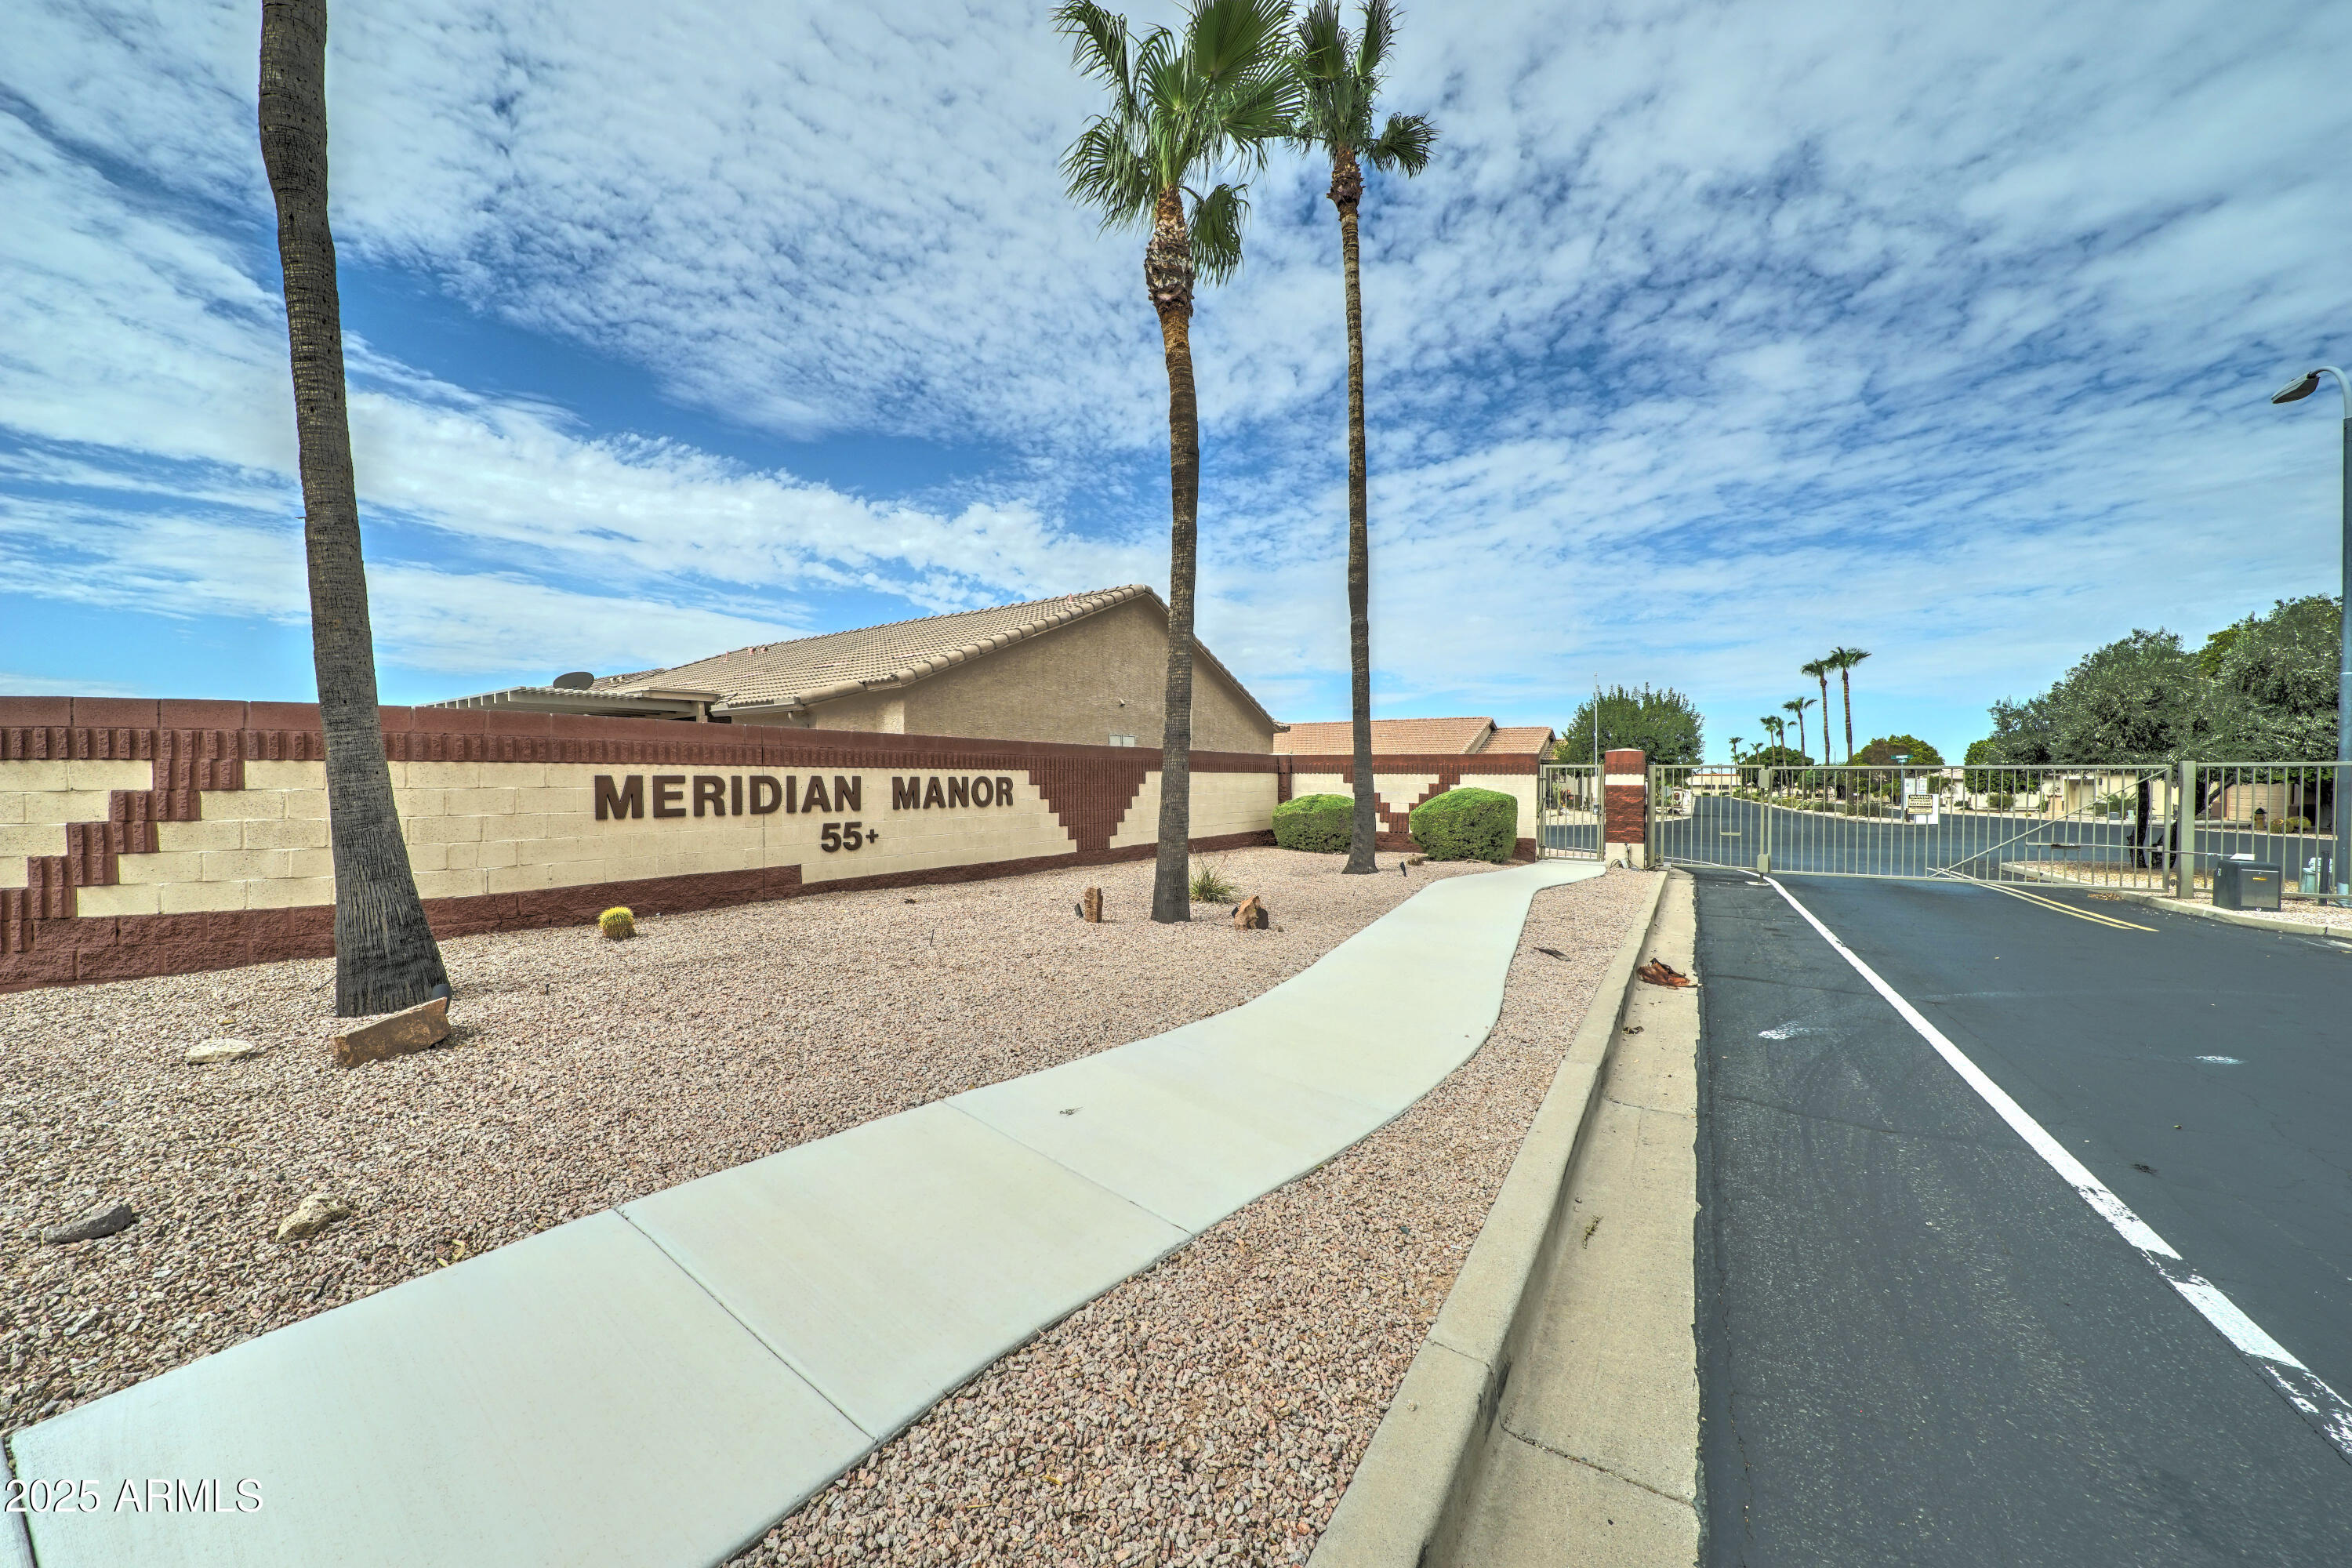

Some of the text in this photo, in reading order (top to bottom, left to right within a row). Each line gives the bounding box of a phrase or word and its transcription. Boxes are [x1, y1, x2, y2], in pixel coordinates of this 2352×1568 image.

[594, 775, 1014, 820] MERIDIAN MANOR
[821, 822, 879, 853] 55+
